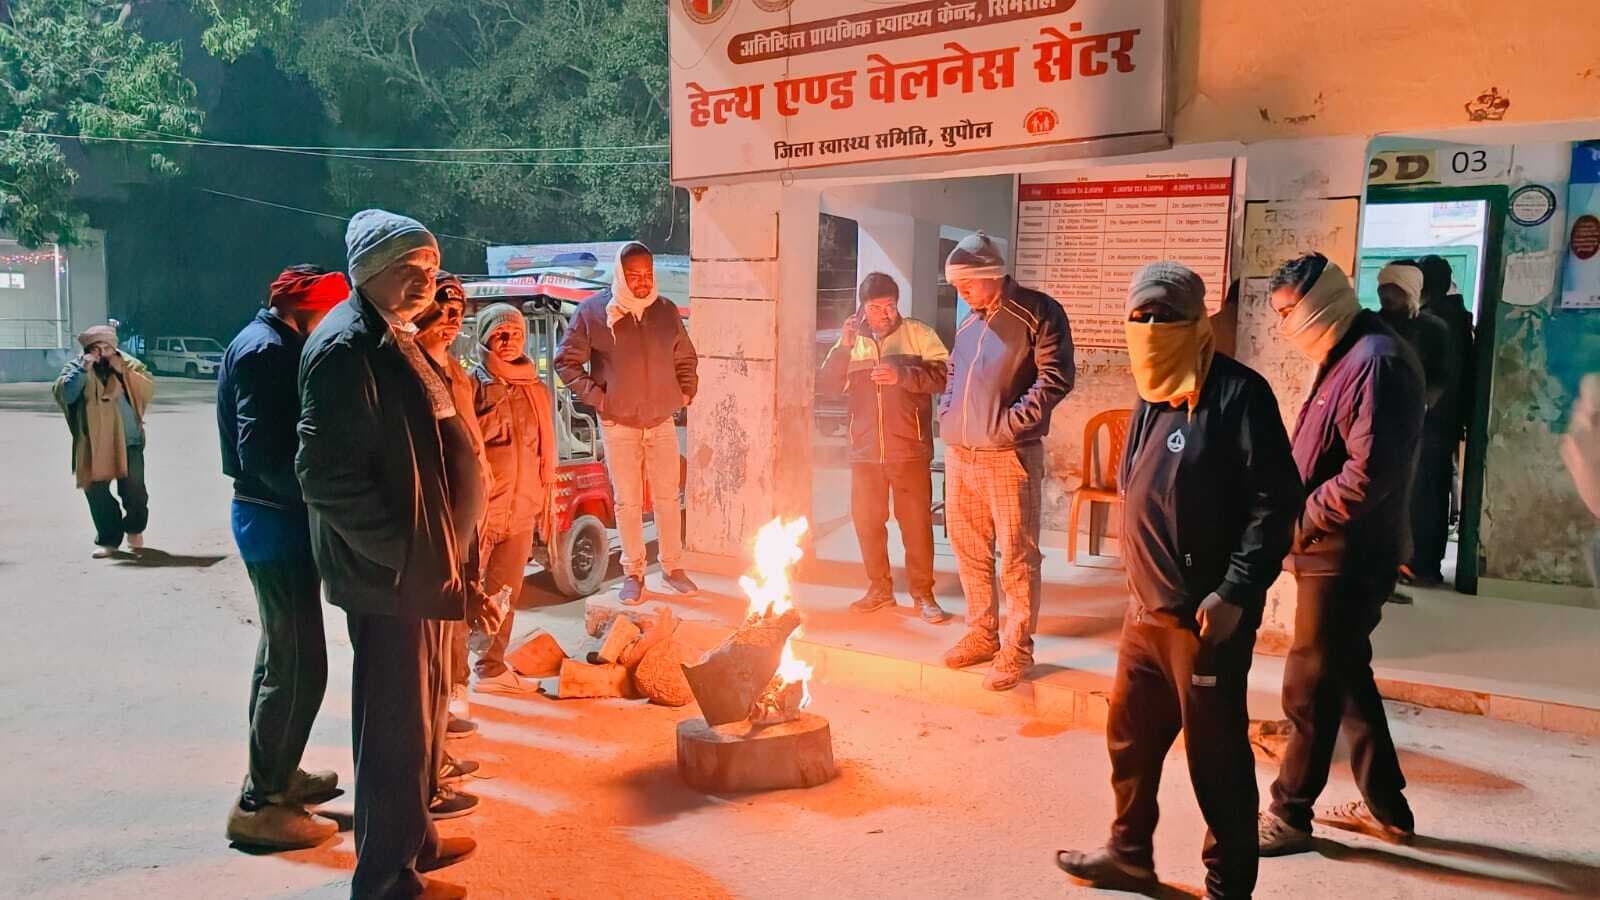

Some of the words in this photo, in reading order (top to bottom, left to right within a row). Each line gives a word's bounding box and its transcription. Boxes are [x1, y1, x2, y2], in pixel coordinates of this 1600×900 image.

[740, 31, 805, 57] अतिरिक्त
[810, 20, 872, 46] प्राथमिक
[876, 11, 932, 34] स्वास्थ्य
[686, 81, 764, 128] हेल्थ
[774, 70, 857, 117] एण्ड
[866, 42, 1020, 104] वेलनेस
[1033, 21, 1141, 83] सेंटर
[774, 141, 814, 160] जिला
[819, 135, 870, 156] स्वास्थ्य
[875, 126, 934, 149] समिति,
[940, 119, 993, 148] सुपौल
[1452, 150, 1488, 174] 03
